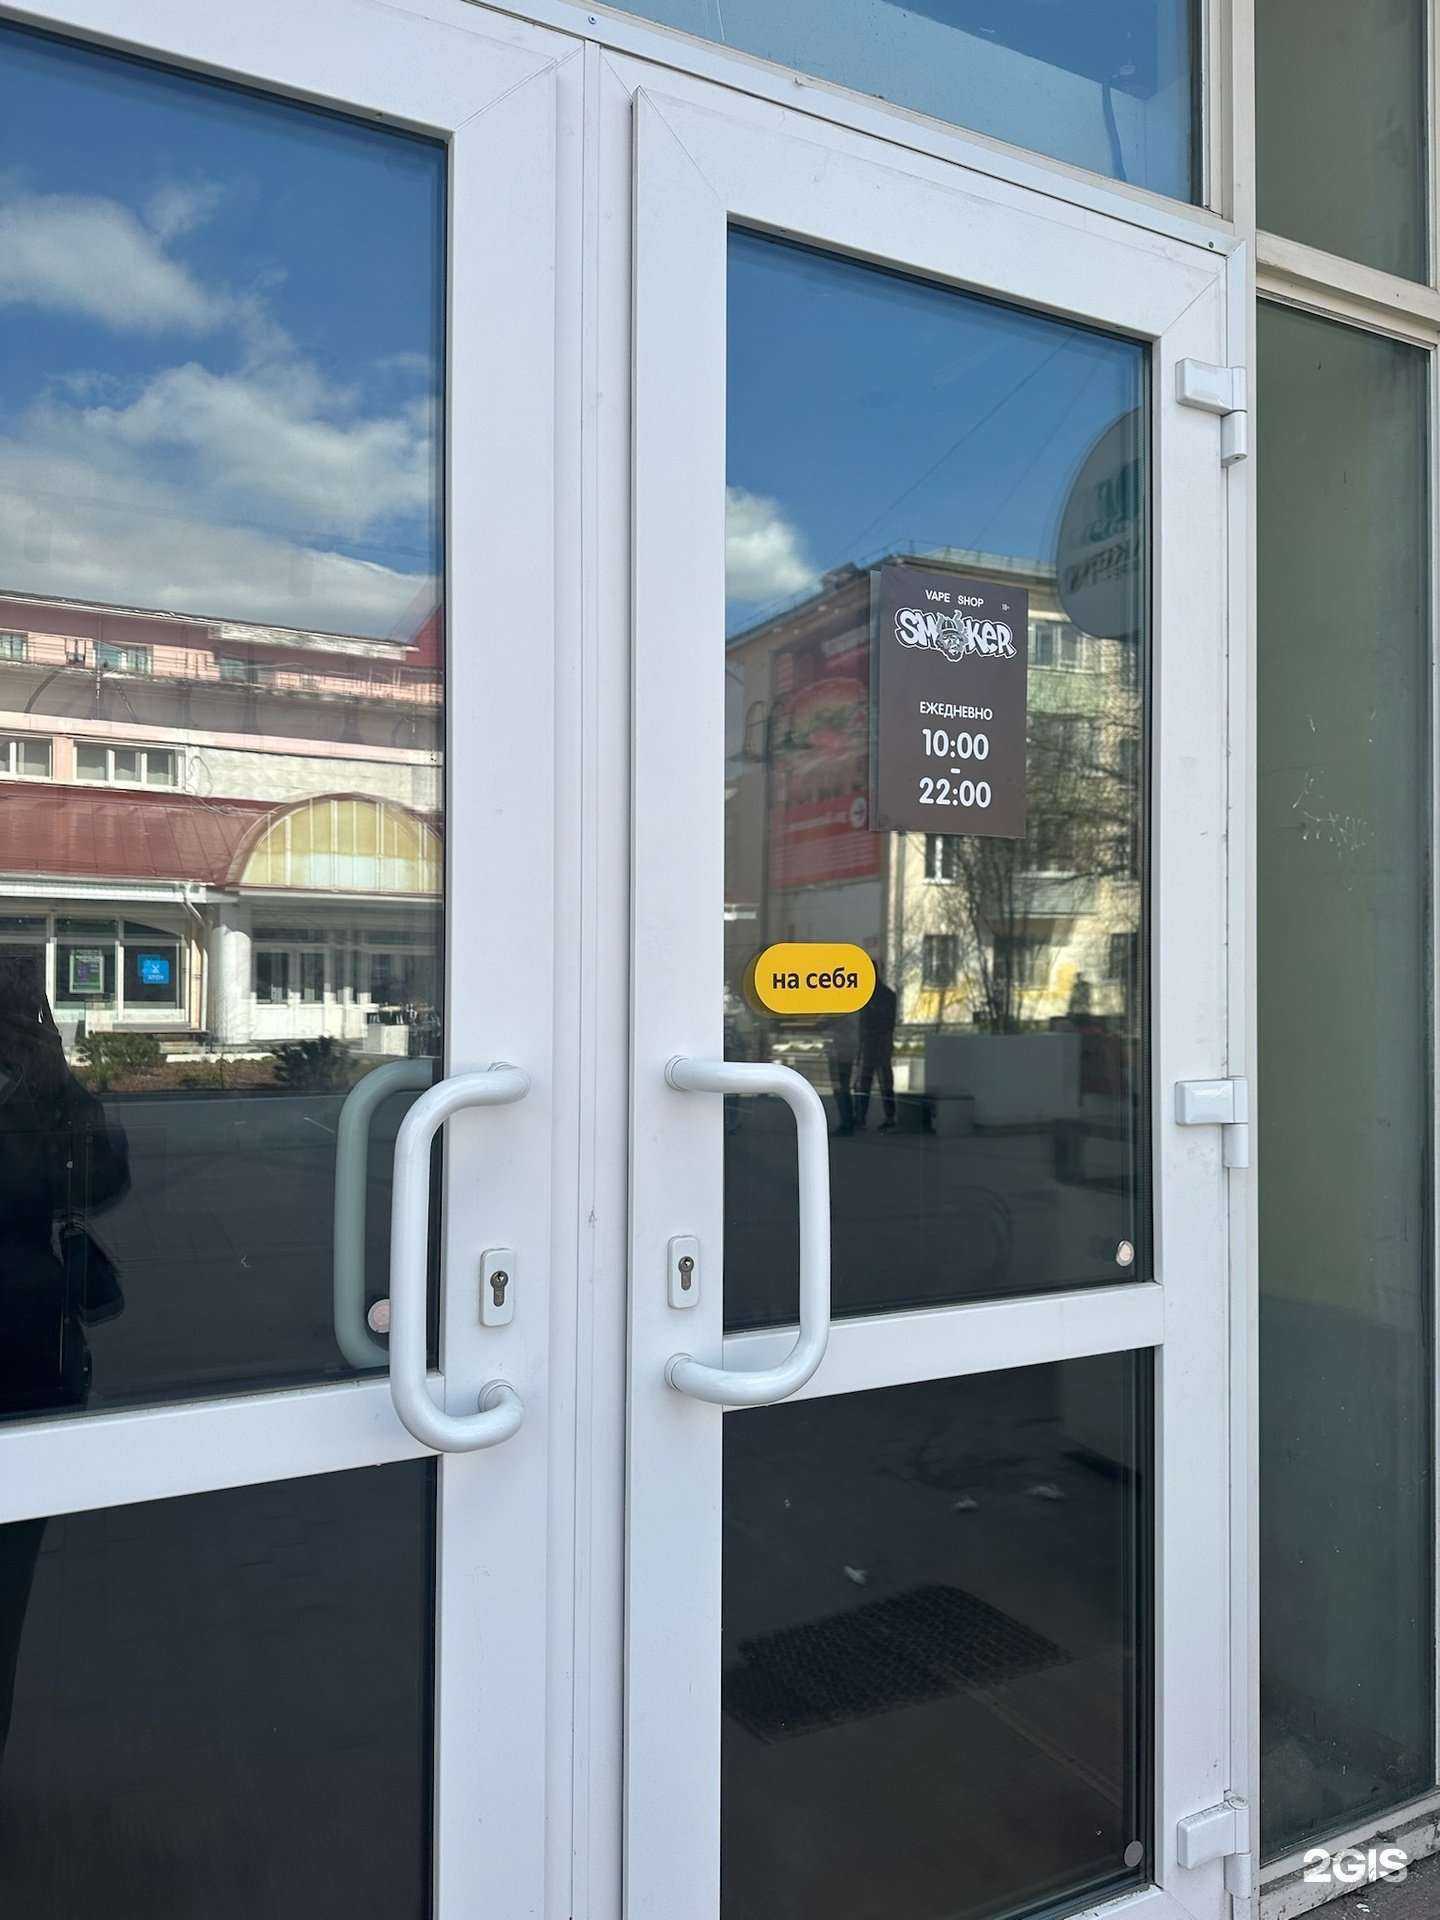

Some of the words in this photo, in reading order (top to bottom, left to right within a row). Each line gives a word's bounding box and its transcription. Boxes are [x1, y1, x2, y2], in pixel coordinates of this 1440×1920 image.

[925, 589, 950, 603] VAPE
[957, 594, 984, 608] SHOP
[919, 701, 993, 721] ЕЖЕДНЕВНО
[922, 728, 989, 760] 10:00
[919, 777, 992, 808] 22:00
[772, 972, 799, 989] на
[806, 967, 858, 989] себя
